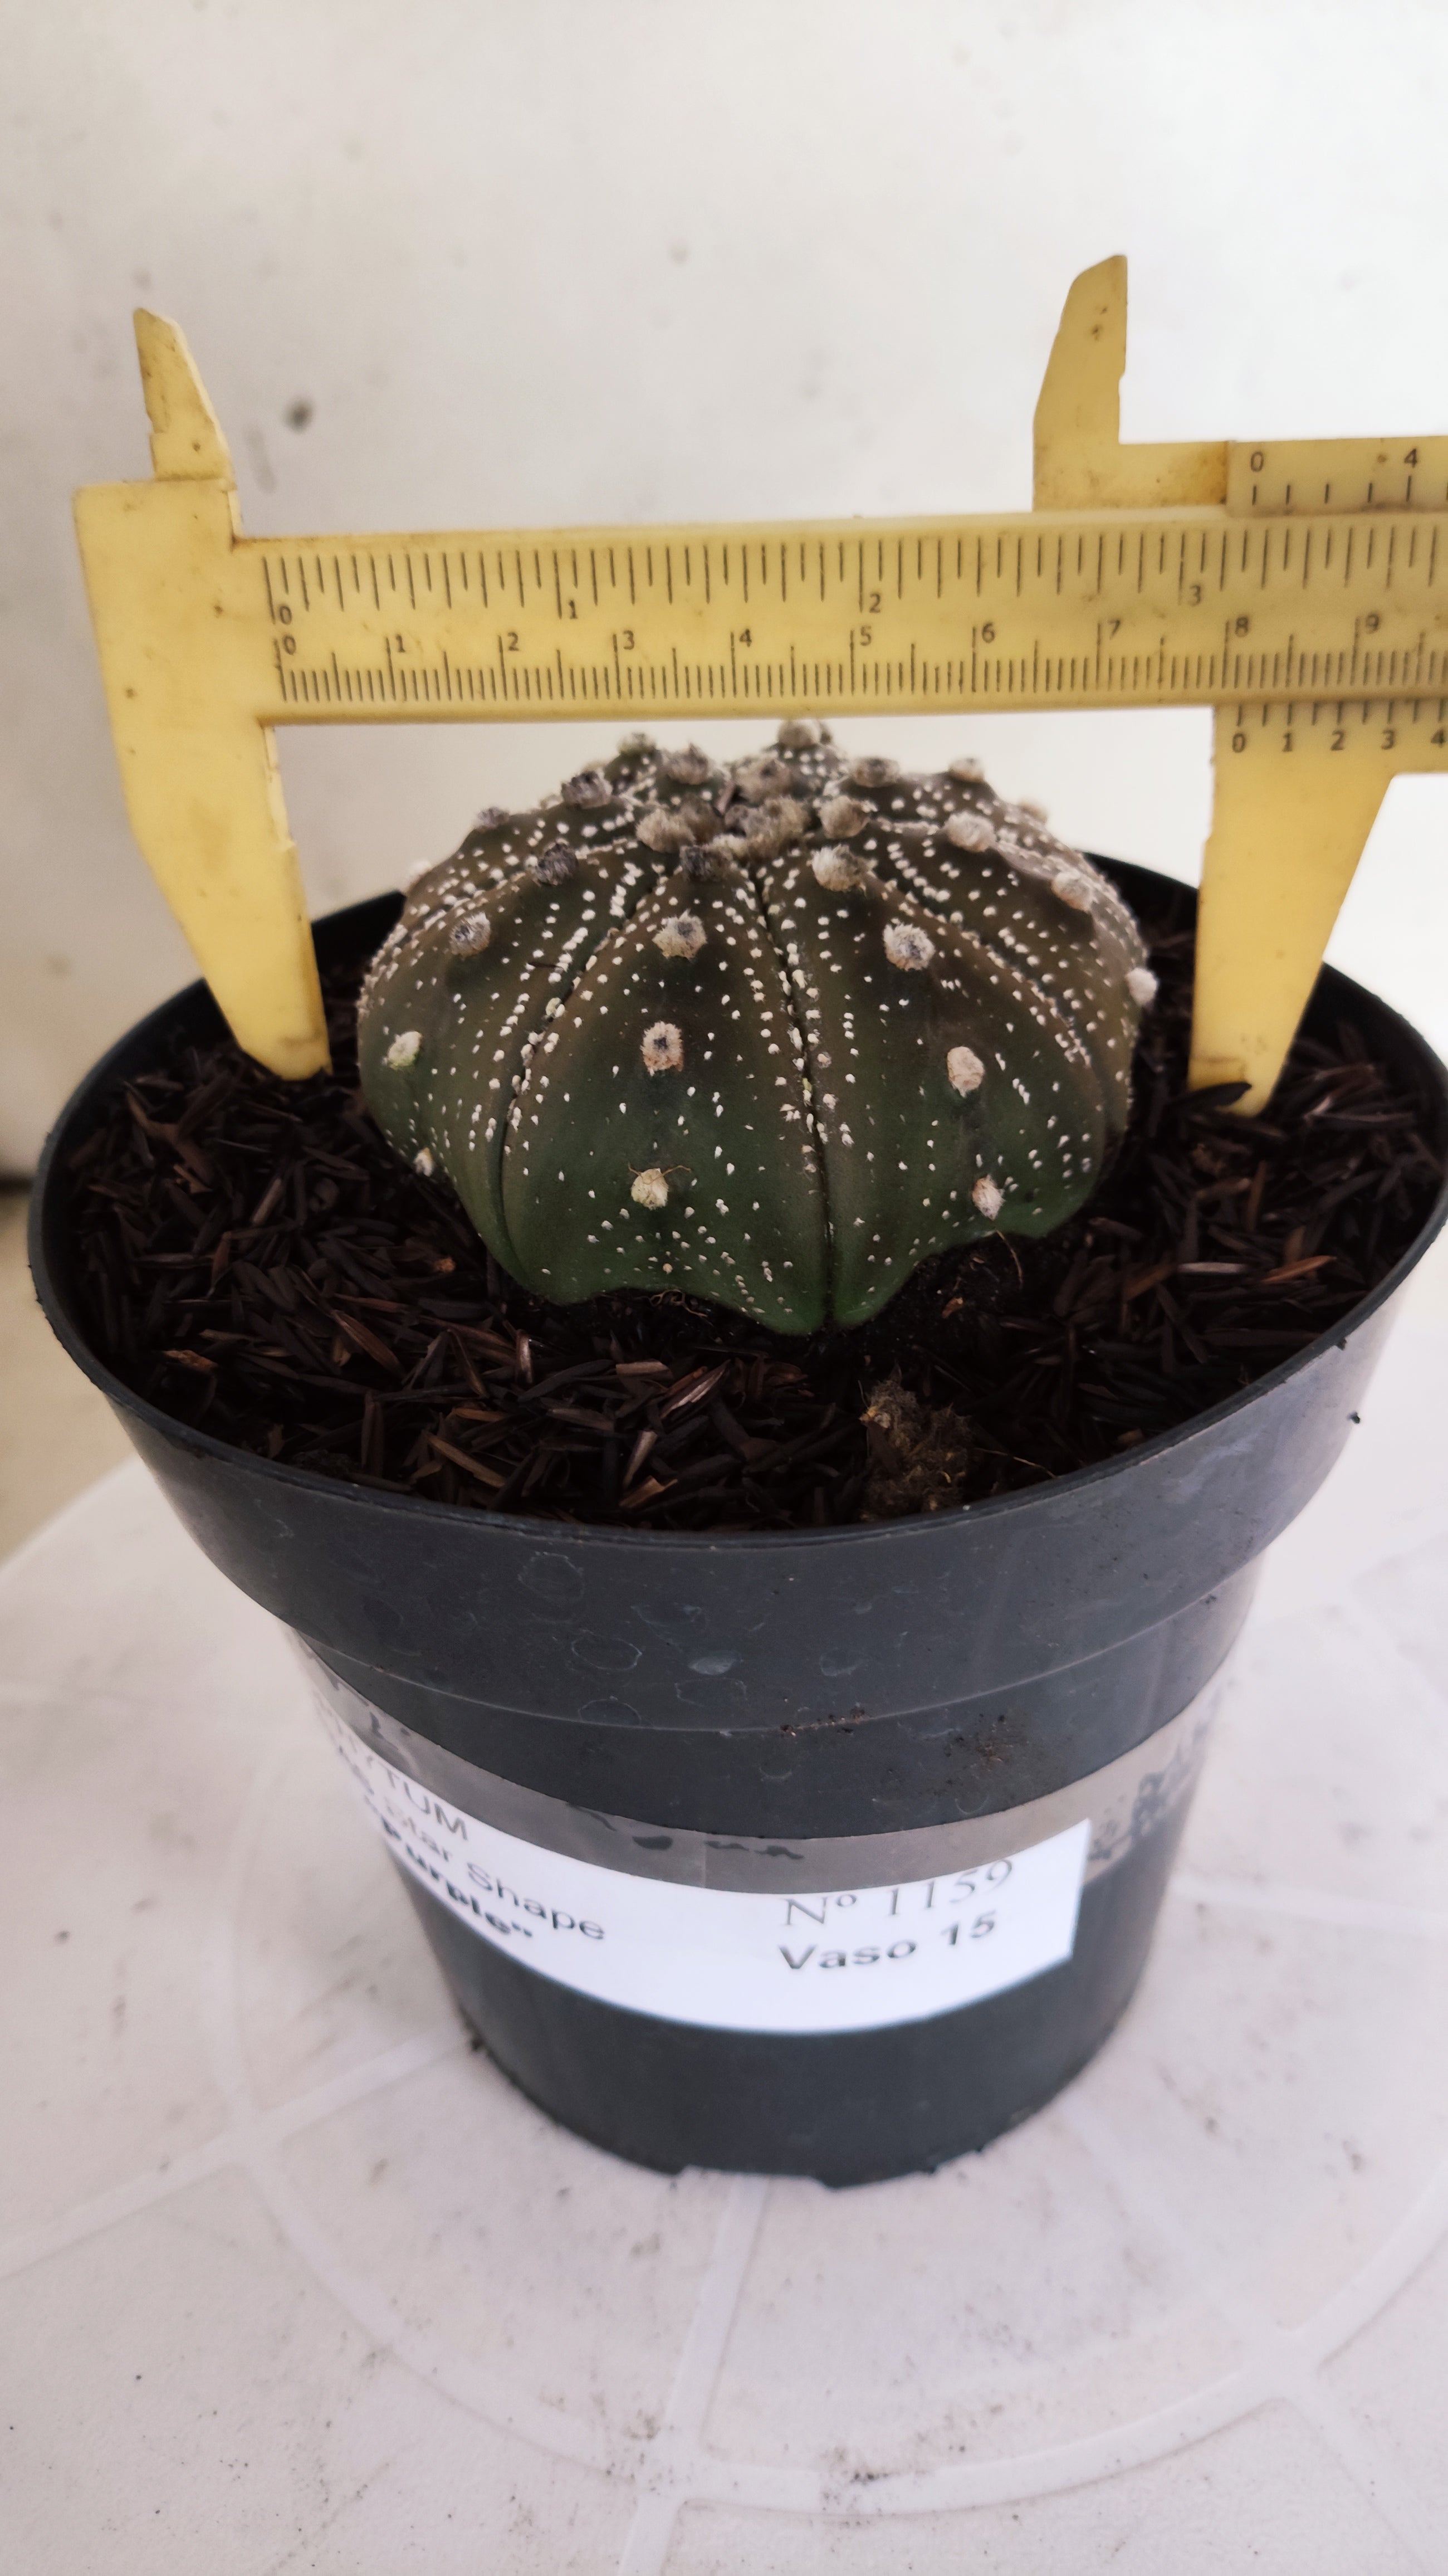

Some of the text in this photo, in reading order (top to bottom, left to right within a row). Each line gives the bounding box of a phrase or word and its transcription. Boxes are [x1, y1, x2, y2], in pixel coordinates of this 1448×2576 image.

[1250, 448, 1418, 472] 0 4
[278, 584, 1202, 625] 0 1 2 3
[282, 613, 1380, 655] 0 1 2 3 4 5 6 7 8 9
[1231, 728, 1446, 753] 0 1 2 3 4
[467, 1861, 606, 1941] Shape
[888, 1858, 1014, 1916] 1159
[778, 1909, 997, 1970] Vaso 15
